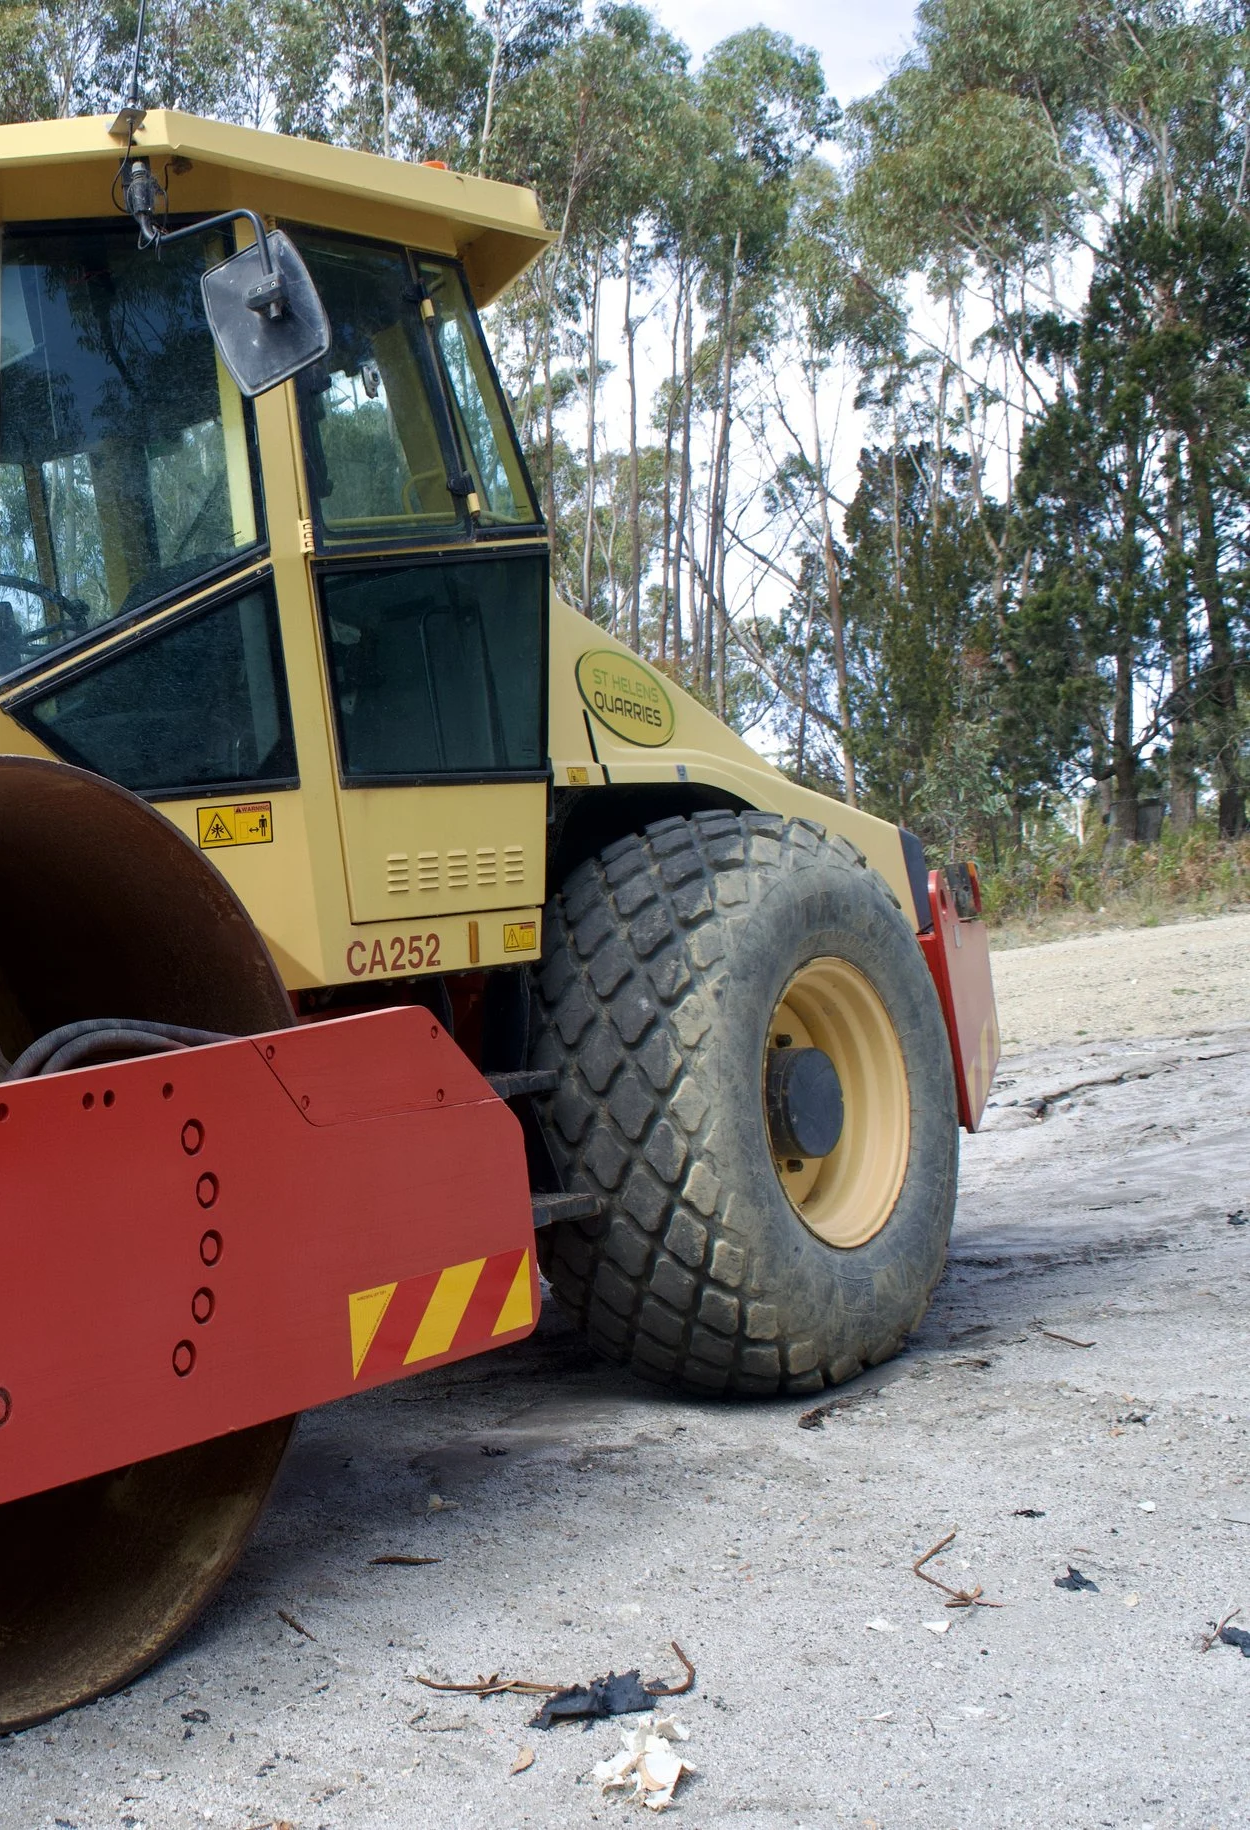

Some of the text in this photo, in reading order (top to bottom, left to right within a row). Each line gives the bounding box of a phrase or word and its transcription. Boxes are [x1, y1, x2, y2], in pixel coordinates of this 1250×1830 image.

[592, 668, 659, 703] ST HELENS
[594, 690, 662, 727] QUARRIES
[242, 804, 269, 813] WARNING
[346, 933, 441, 976] CA252
